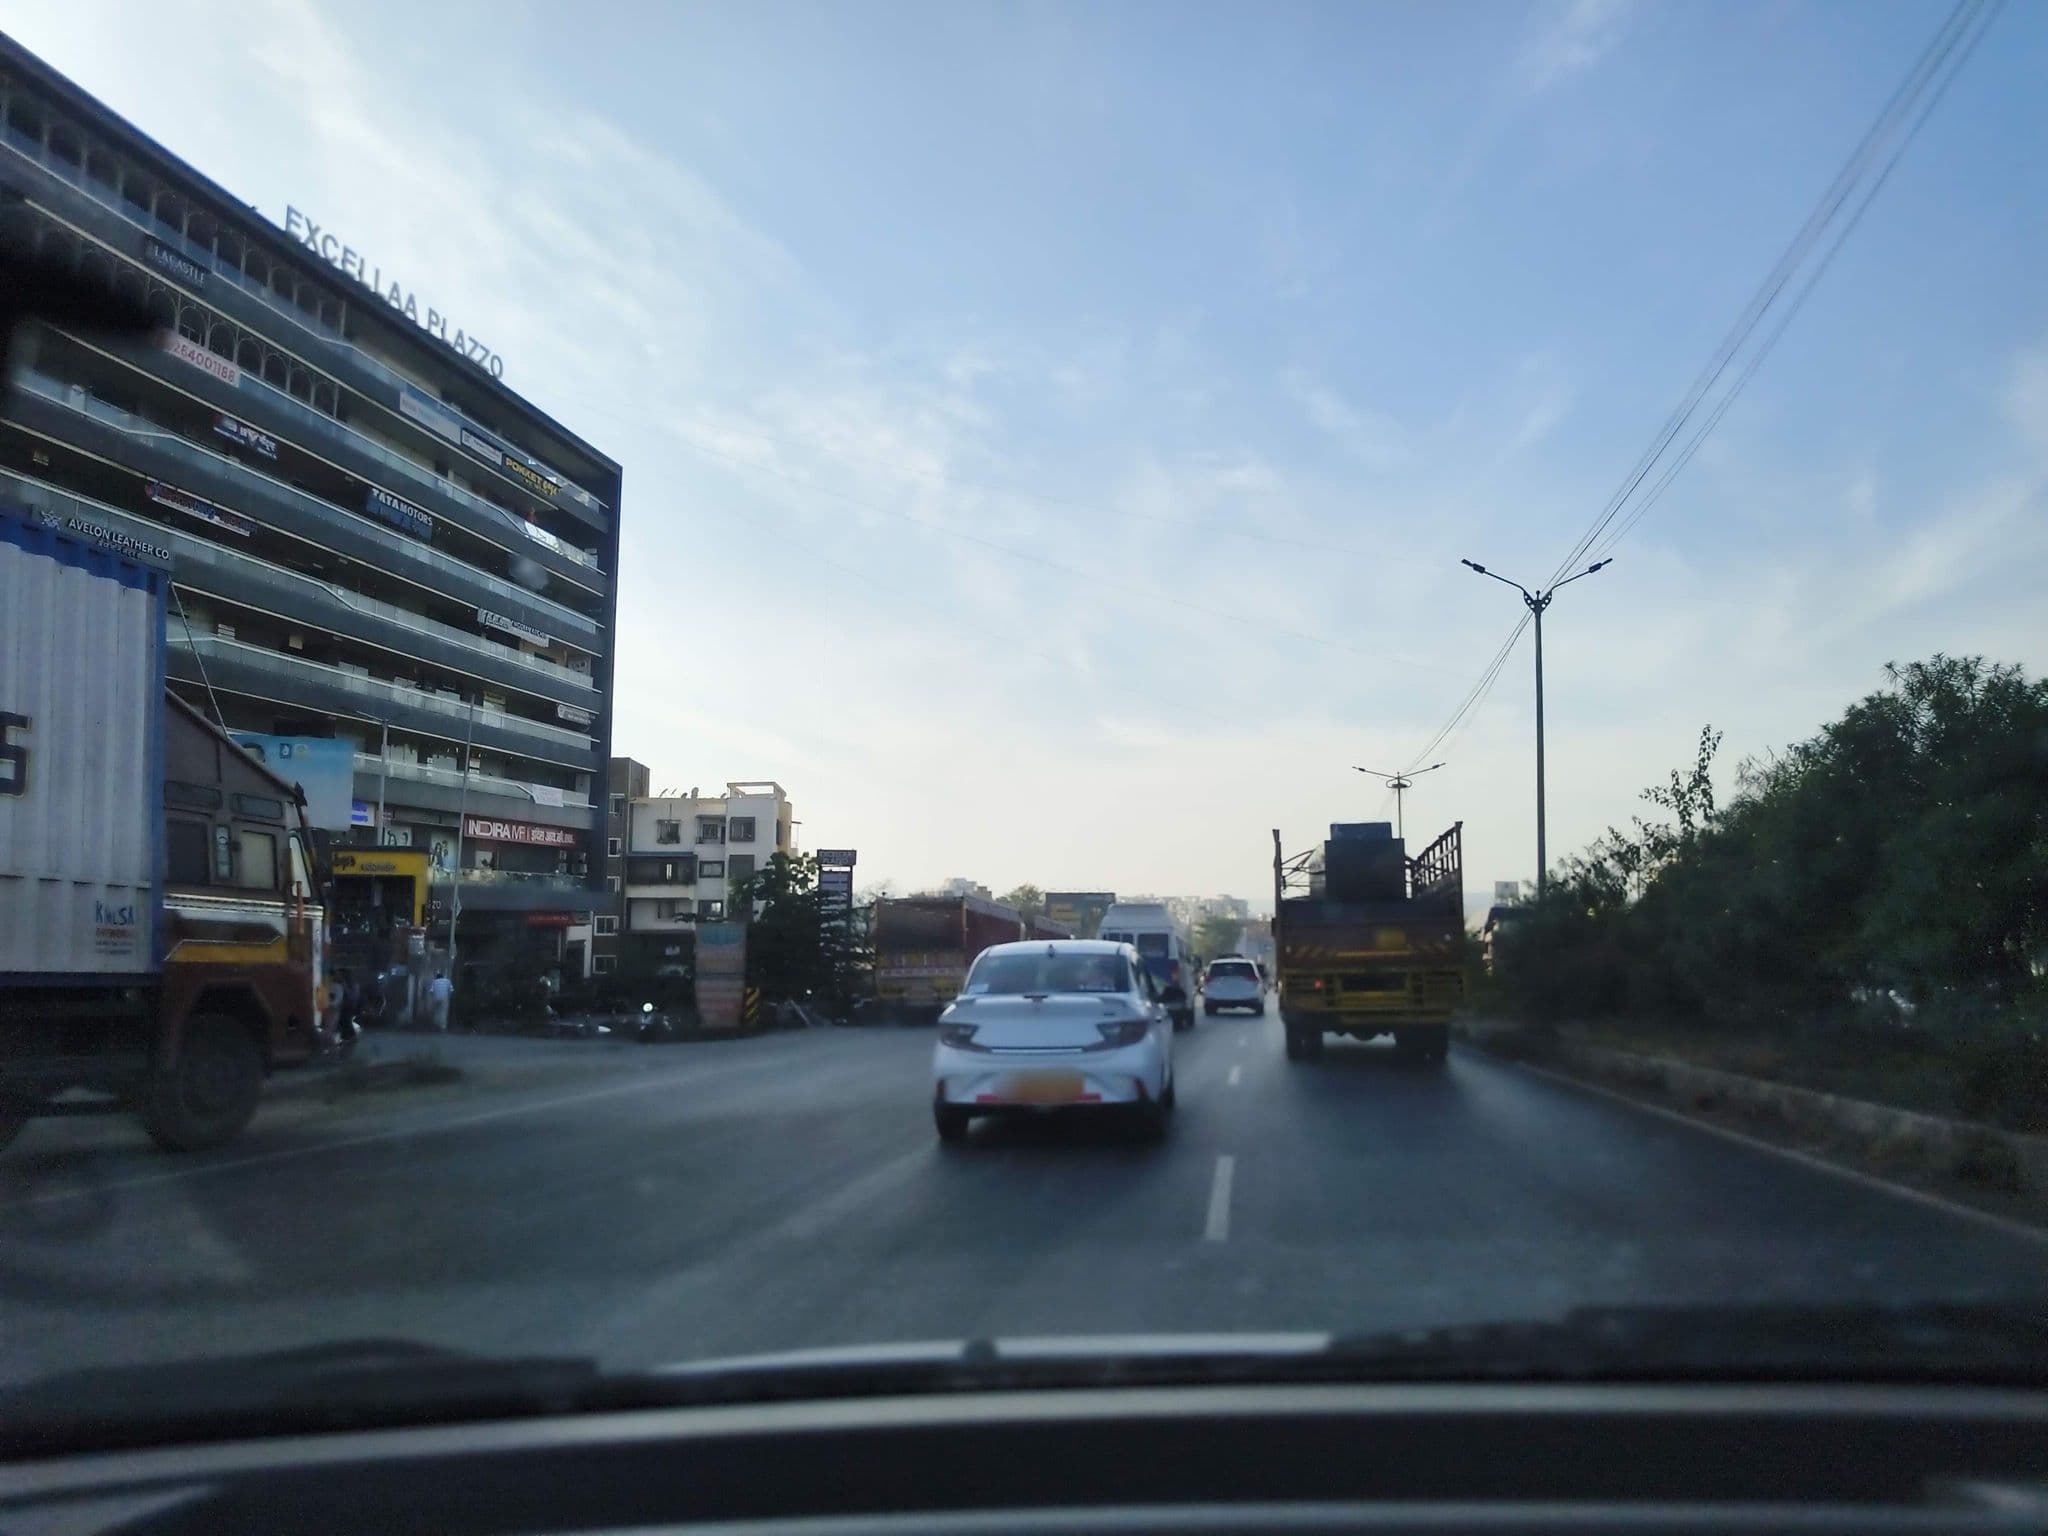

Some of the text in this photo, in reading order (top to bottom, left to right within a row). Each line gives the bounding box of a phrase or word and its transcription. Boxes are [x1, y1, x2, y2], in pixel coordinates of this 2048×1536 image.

[286, 204, 504, 380] EXCELLAA PLAZZO
[371, 487, 433, 526] TATA MOTORS
[68, 518, 111, 540] AVELON
[112, 530, 154, 553] LEATHER
[468, 819, 511, 840] INDIRA
